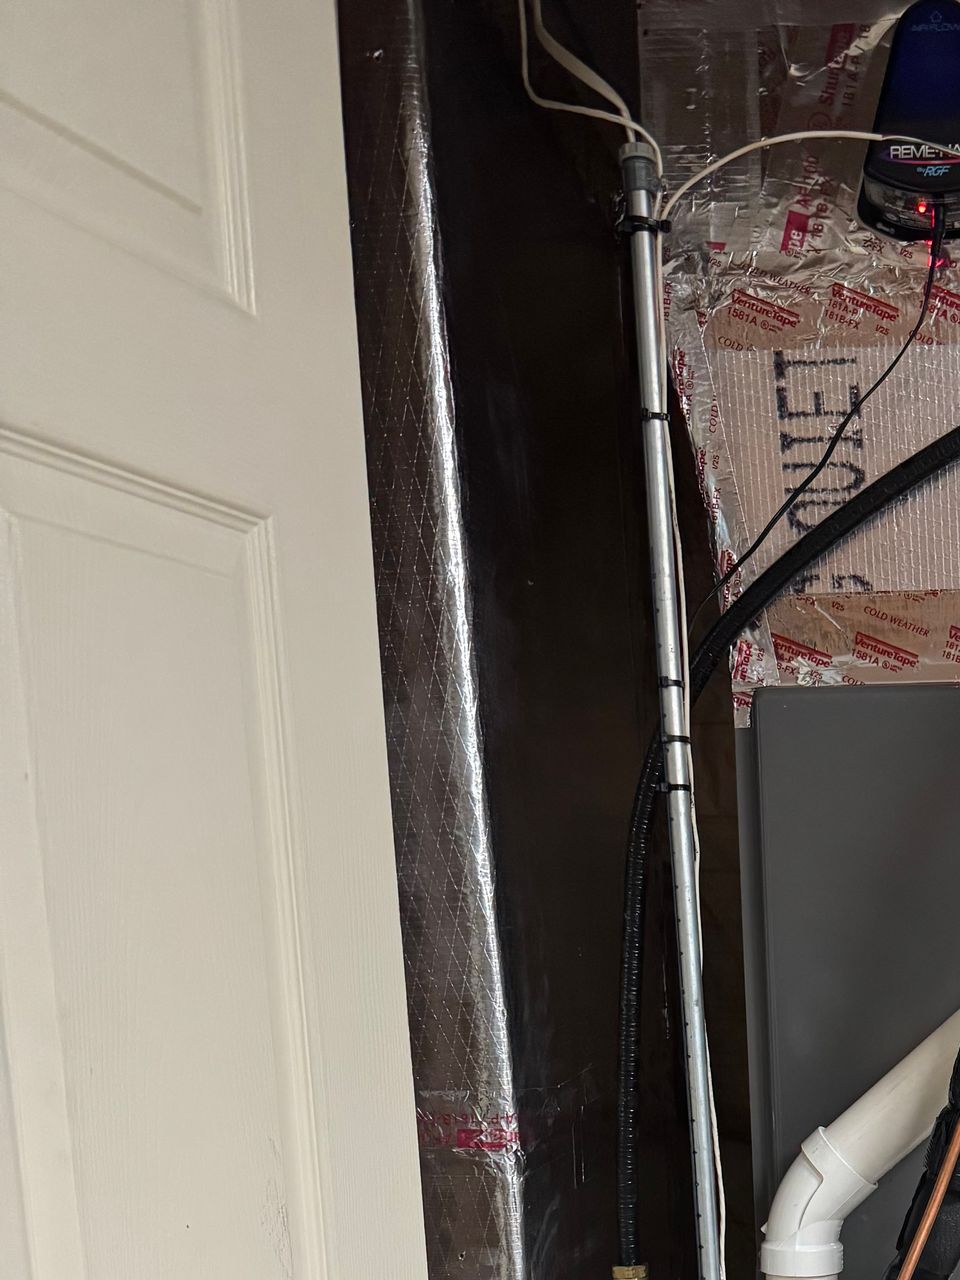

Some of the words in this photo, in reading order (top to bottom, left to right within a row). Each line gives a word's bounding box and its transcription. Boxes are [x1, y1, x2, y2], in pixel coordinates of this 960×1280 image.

[924, 165, 952, 177] RGF
[727, 306, 758, 326] 1581A
[731, 292, 799, 328] VentureTape
[832, 287, 899, 322] VentureTape
[864, 606, 888, 621] COLD
[890, 615, 930, 637] WEATHER
[852, 649, 879, 666] 1581A
[855, 636, 917, 668] VentureTape
